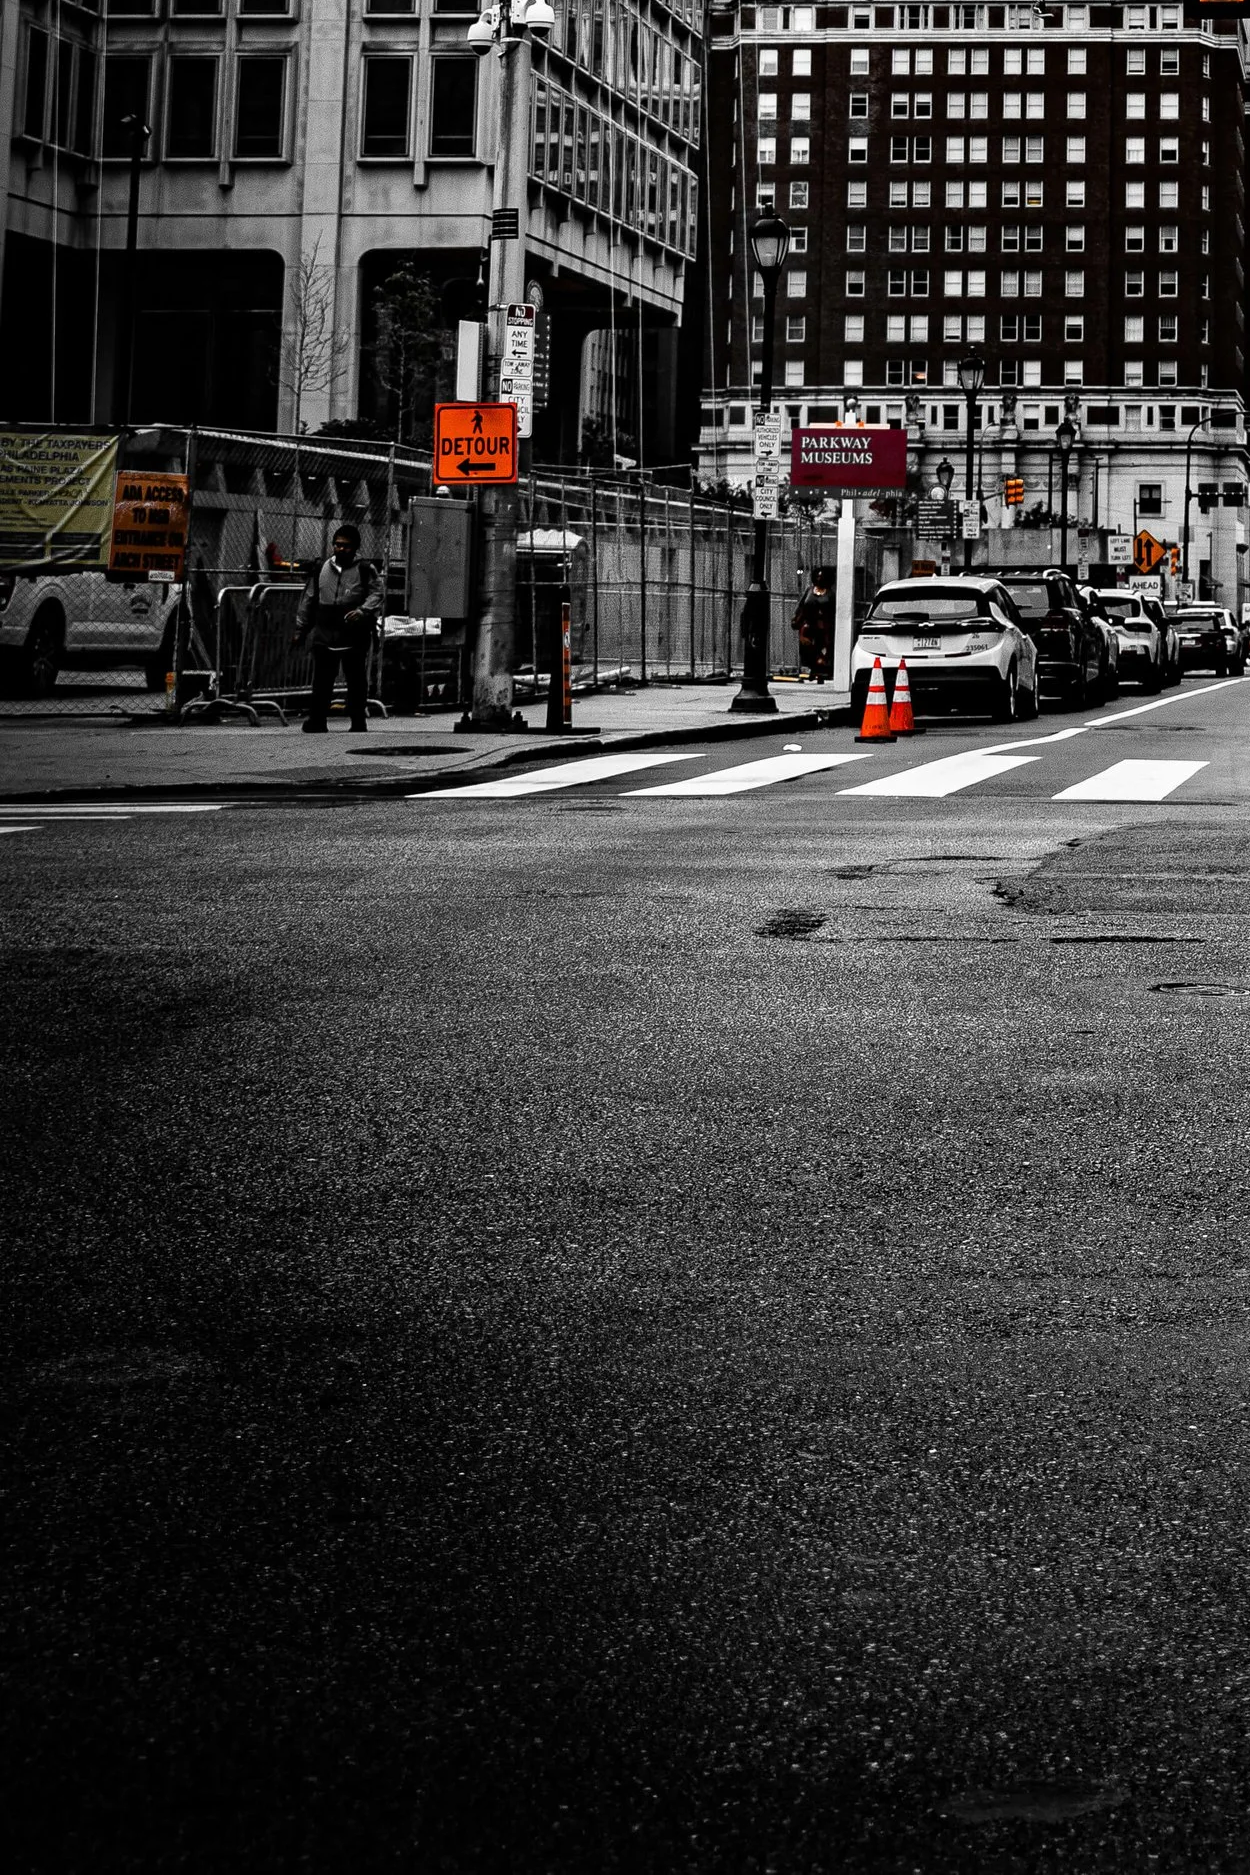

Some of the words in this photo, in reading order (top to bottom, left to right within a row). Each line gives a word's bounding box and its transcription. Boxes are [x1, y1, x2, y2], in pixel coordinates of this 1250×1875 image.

[515, 306, 526, 317] NO
[508, 317, 533, 325] STOPPING
[512, 340, 528, 348] TIME
[502, 381, 512, 392] NO
[756, 414, 765, 425] NO
[1, 438, 16, 446] BY
[47, 440, 110, 449] TAXPAYERS
[441, 437, 510, 455] DETOUR
[801, 437, 872, 449] PARKWAY
[801, 452, 873, 464] MUSEUMS
[17, 466, 47, 474] PAINE
[122, 485, 142, 501] ADA
[145, 486, 184, 502] ACCESS
[132, 508, 147, 524] TO
[143, 553, 180, 569] STREET
[1132, 581, 1159, 590] AHEAD
